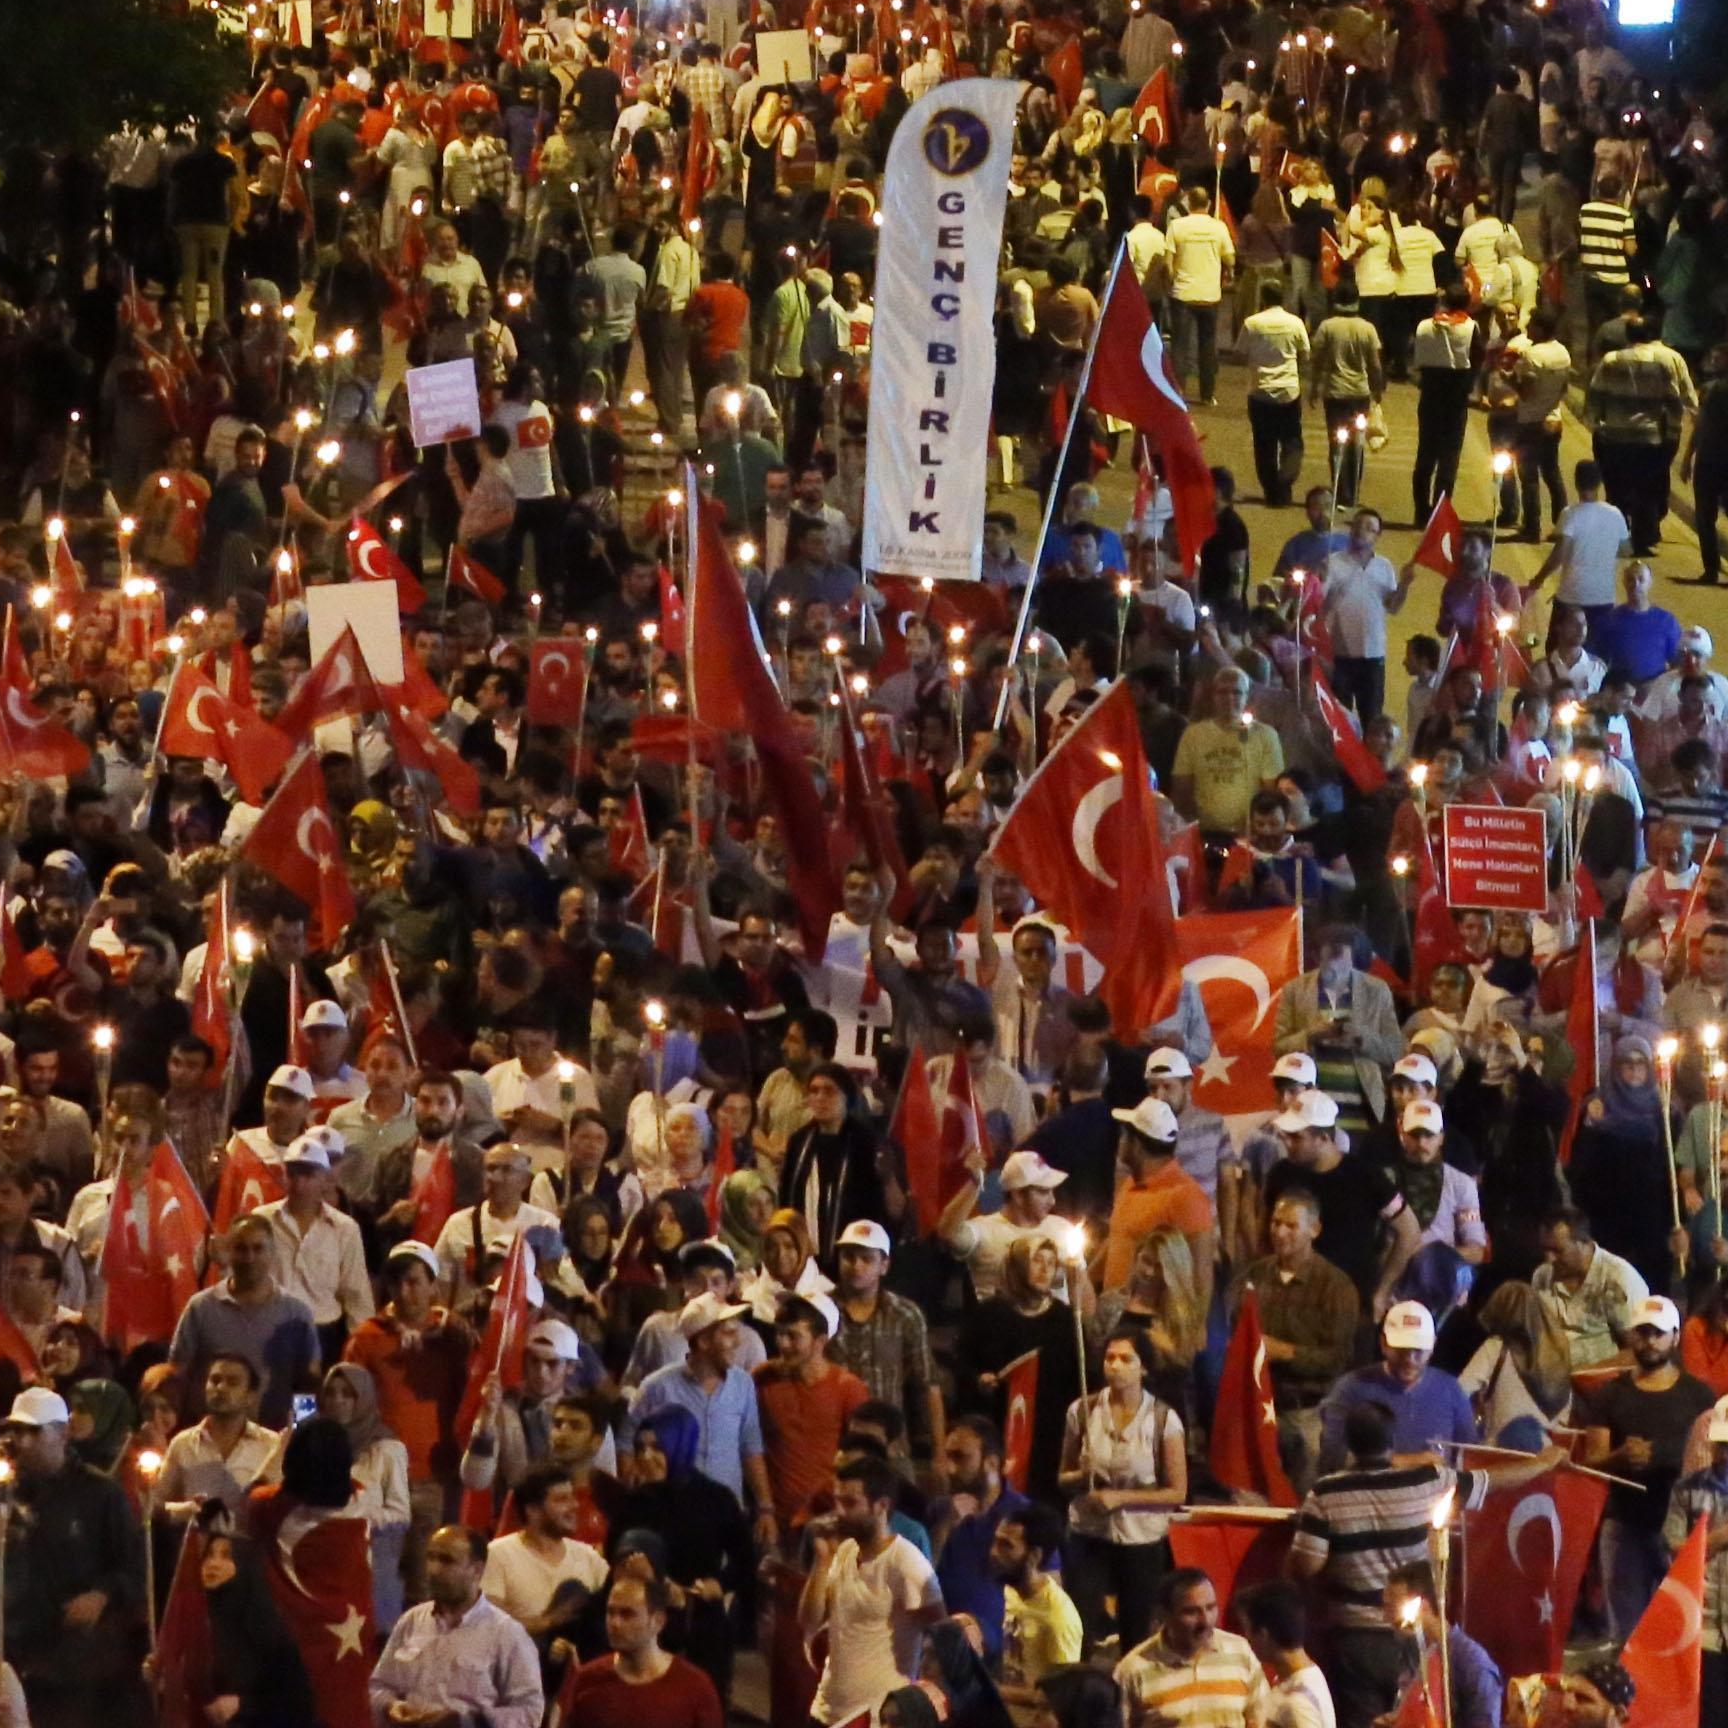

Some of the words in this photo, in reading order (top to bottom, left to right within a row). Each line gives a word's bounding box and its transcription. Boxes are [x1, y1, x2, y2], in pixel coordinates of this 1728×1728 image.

[930, 190, 966, 321] GENÇ
[907, 342, 958, 536] BİRLİK
[1464, 815, 1480, 829] Bu
[1482, 817, 1526, 831] Milletin
[1453, 857, 1484, 870] Nene
[1486, 857, 1539, 874] Hatunları
[1475, 879, 1521, 894] Bitmez!
